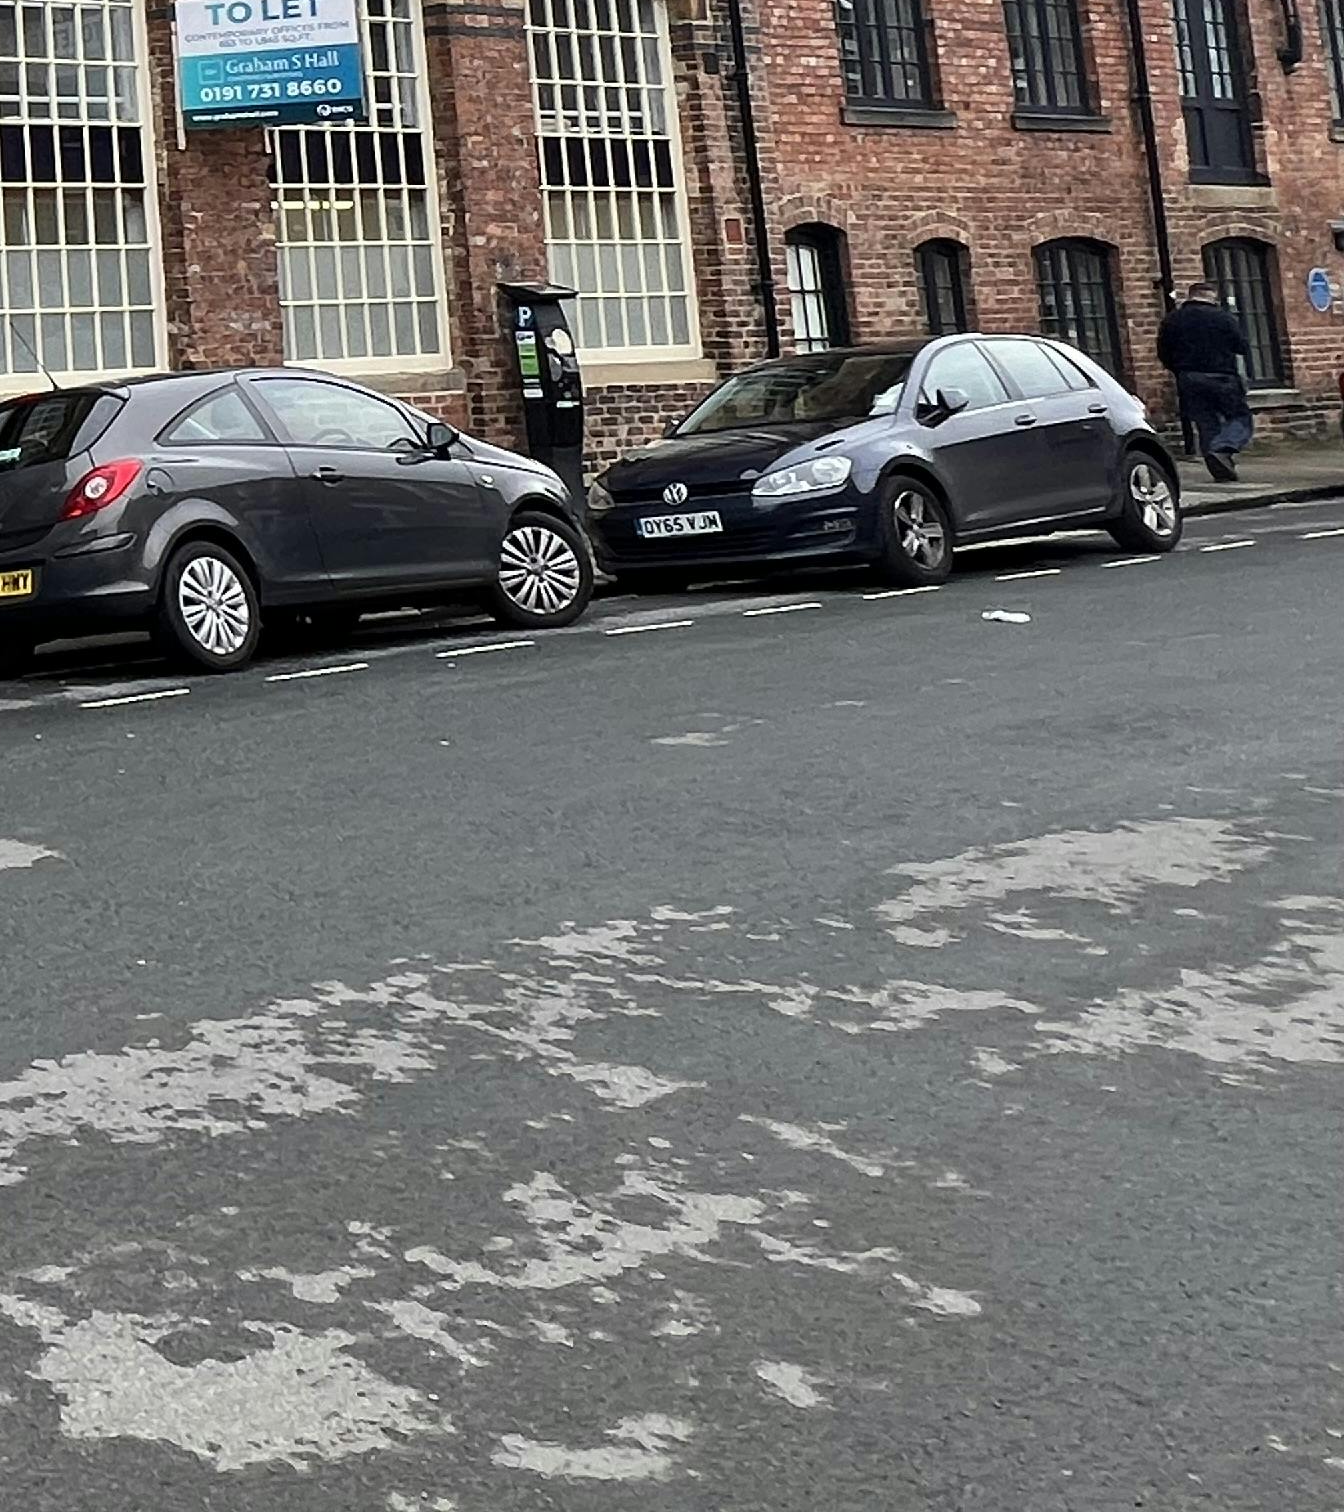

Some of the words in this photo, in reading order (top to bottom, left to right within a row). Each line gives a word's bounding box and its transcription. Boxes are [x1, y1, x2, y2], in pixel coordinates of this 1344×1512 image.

[205, 2, 252, 26] TO
[271, 23, 316, 35] OFFICES
[317, 20, 350, 30] FROM
[225, 55, 290, 75] Graham
[292, 54, 303, 70] S
[305, 50, 340, 69] Hall
[200, 85, 243, 102] 0191
[246, 82, 281, 99] 731
[286, 78, 342, 97] 8660
[518, 306, 532, 327] P
